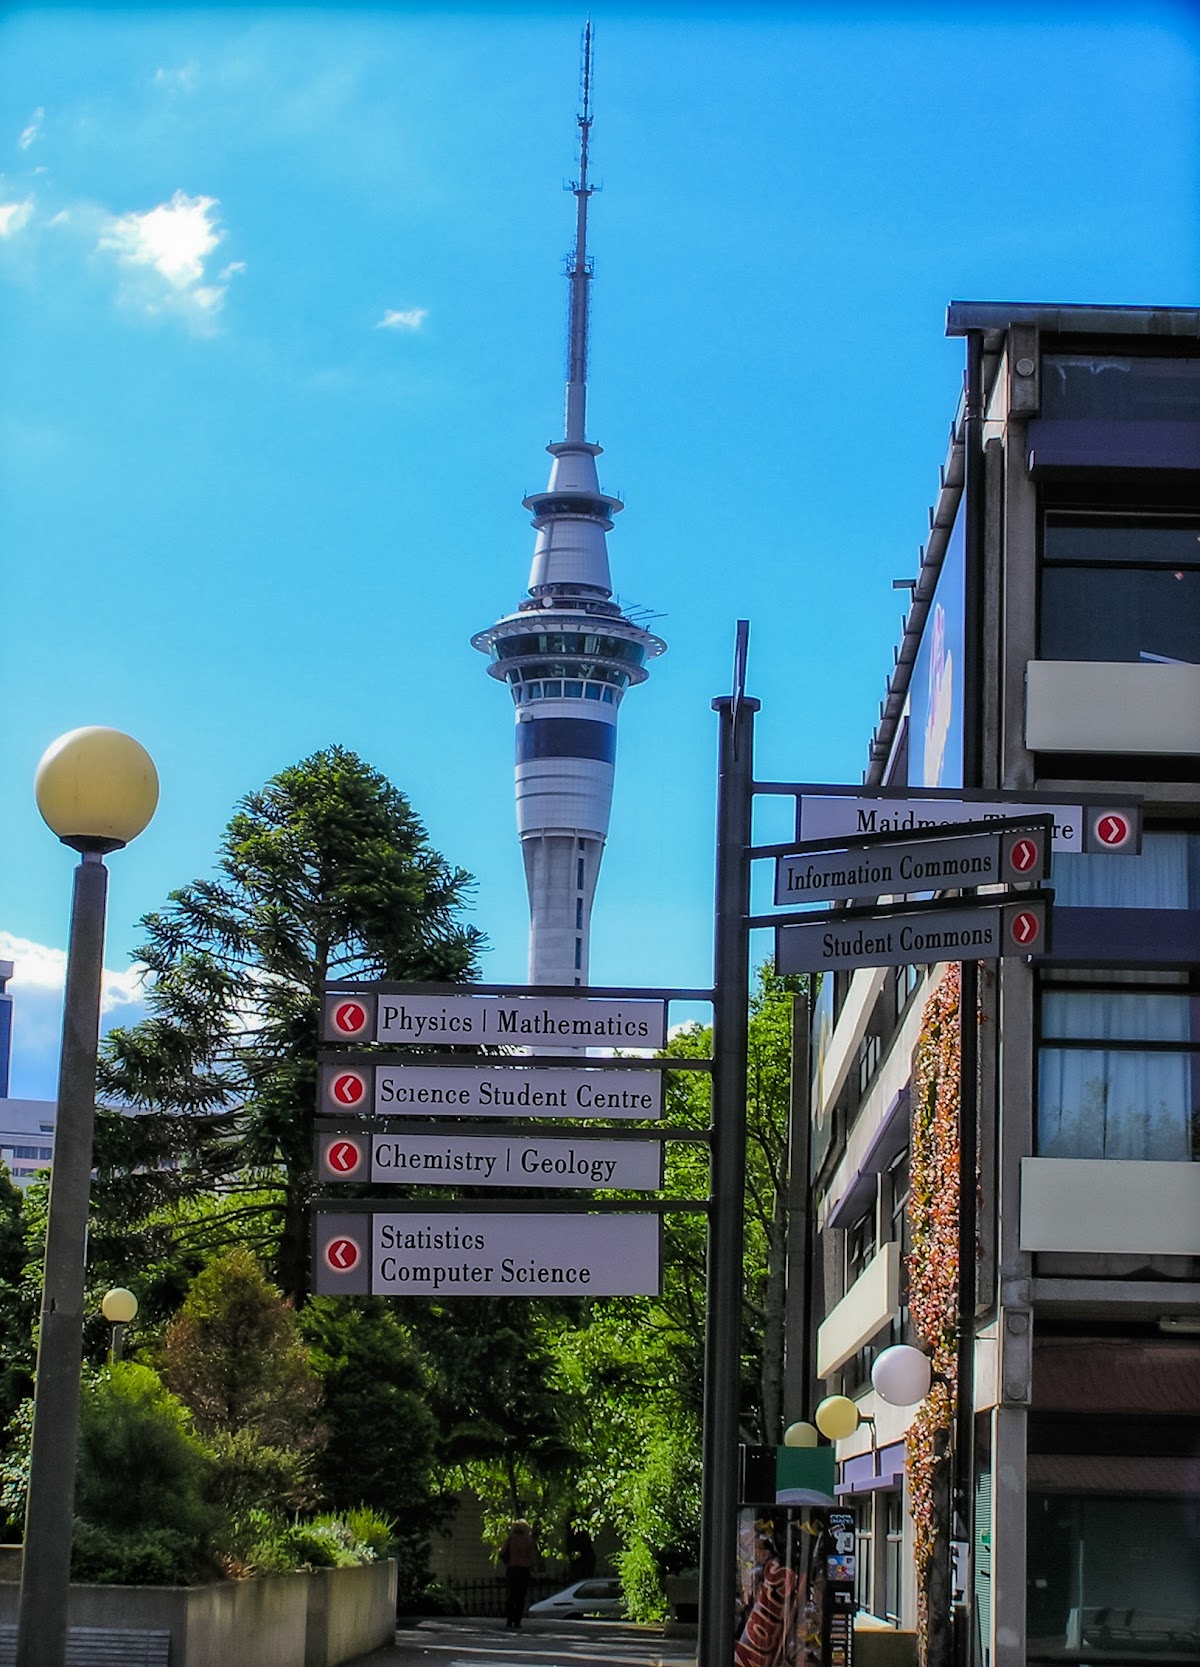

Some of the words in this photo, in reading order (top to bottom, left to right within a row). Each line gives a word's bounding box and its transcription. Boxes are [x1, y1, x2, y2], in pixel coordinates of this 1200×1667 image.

[787, 860, 893, 891] Information
[899, 854, 992, 880] Commons
[822, 931, 893, 958] Student
[899, 926, 993, 951] Commons
[382, 1006, 473, 1037] Physics
[496, 1009, 649, 1037] Mathematics
[381, 1079, 470, 1104] Science
[478, 1082, 567, 1107] Student
[576, 1084, 652, 1109] Centre
[375, 1144, 497, 1178] Chemistry
[520, 1149, 617, 1182] Geology
[380, 1225, 485, 1250] Statistics
[380, 1257, 494, 1289] Computer
[501, 1259, 591, 1284] Science
